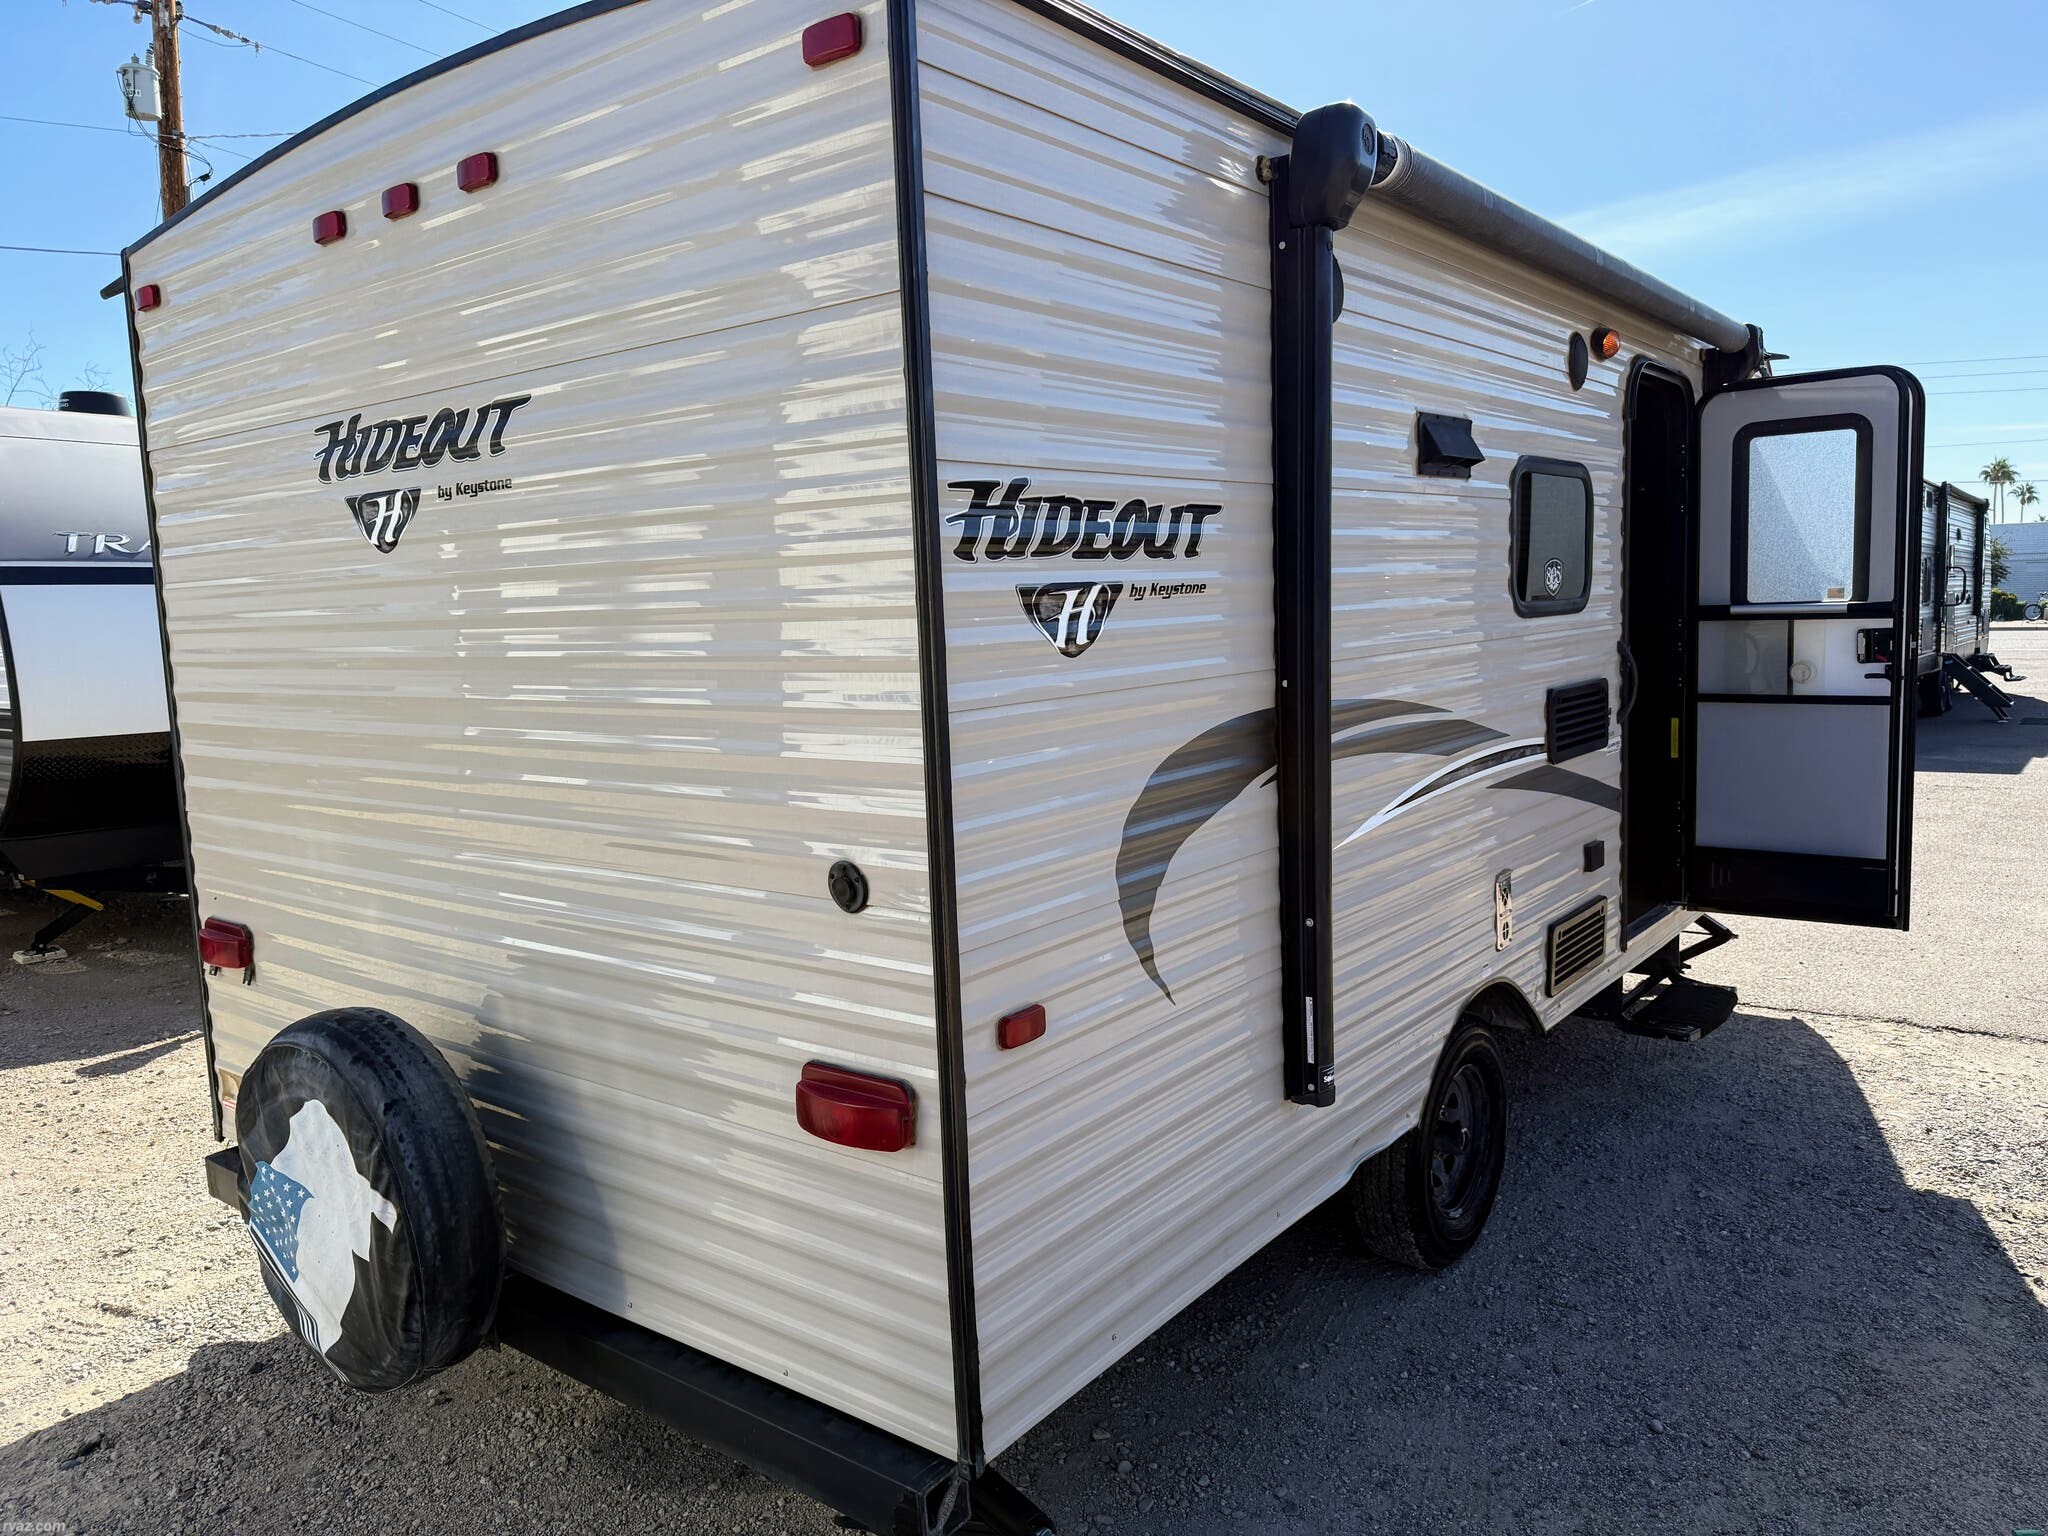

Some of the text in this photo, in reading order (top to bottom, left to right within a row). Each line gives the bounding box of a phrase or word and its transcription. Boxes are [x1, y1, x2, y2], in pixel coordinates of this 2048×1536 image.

[313, 393, 532, 485] HIDEOUT
[437, 478, 512, 501] by Keystone
[945, 477, 1225, 564] HIDEOUT
[1129, 582, 1207, 601] by Keystone
